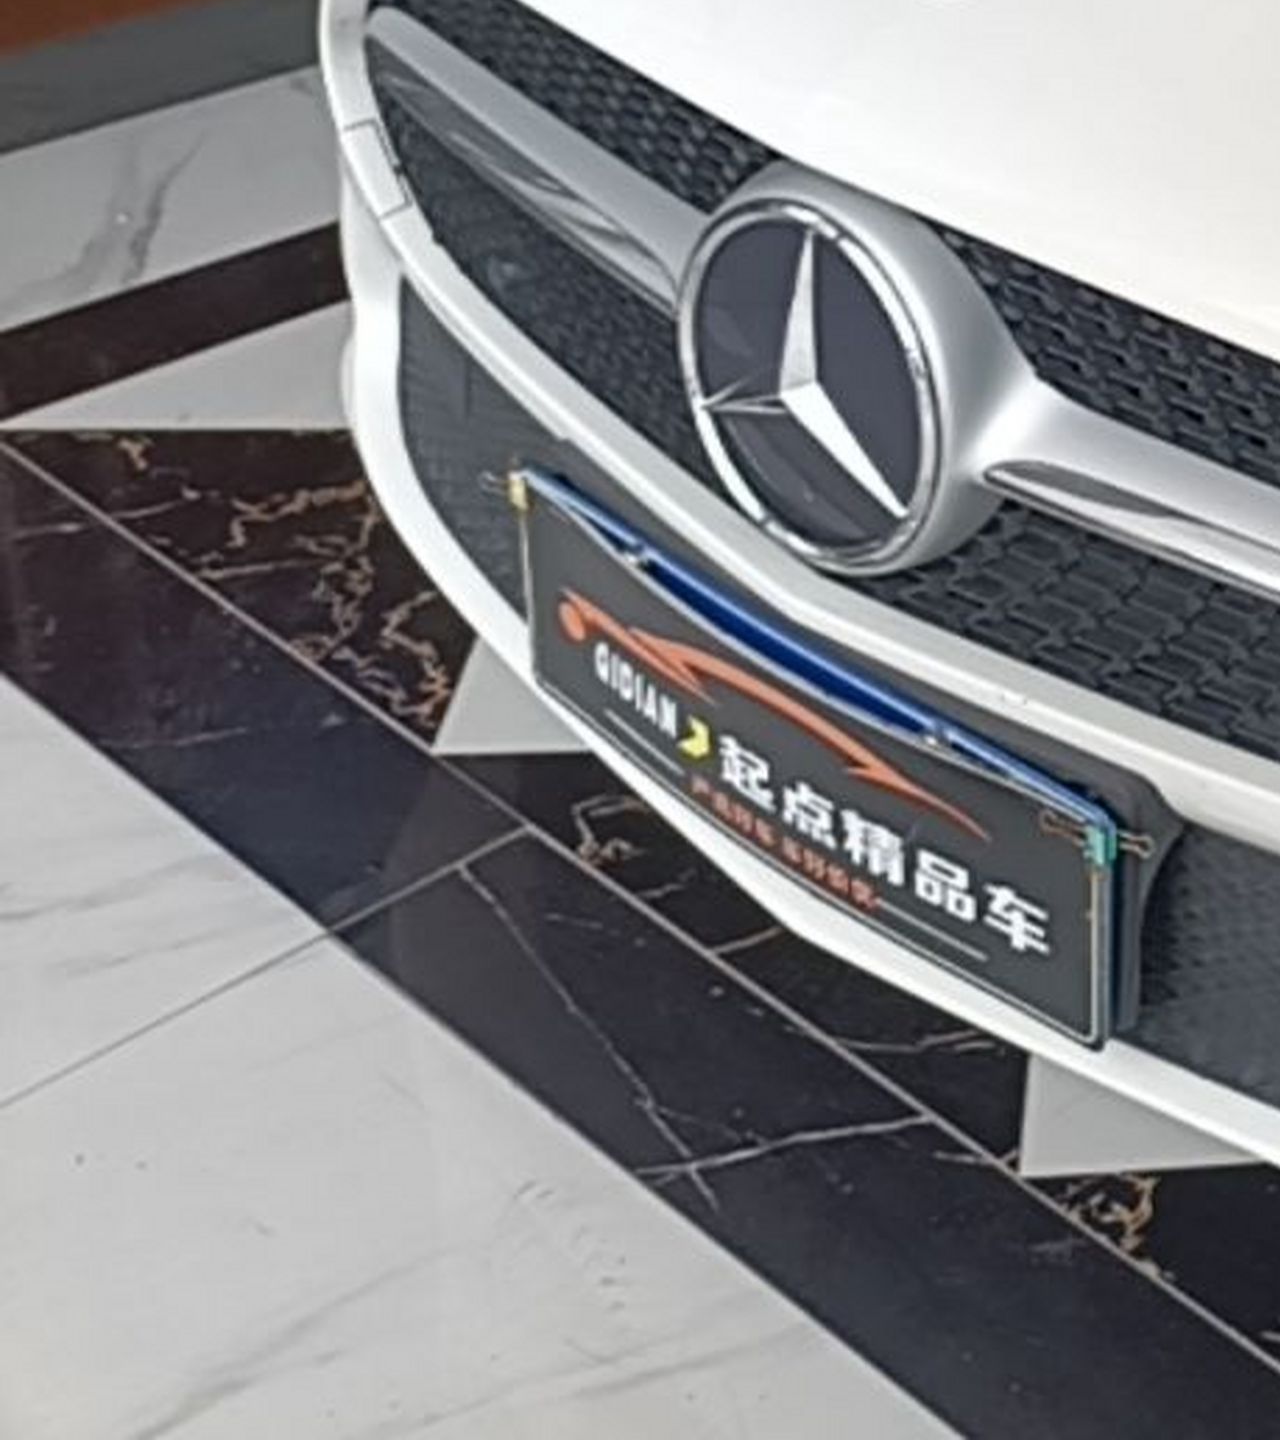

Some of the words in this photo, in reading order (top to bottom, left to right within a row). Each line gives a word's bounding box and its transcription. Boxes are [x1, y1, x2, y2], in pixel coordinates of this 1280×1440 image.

[718, 734, 1049, 953] 起点精品车
